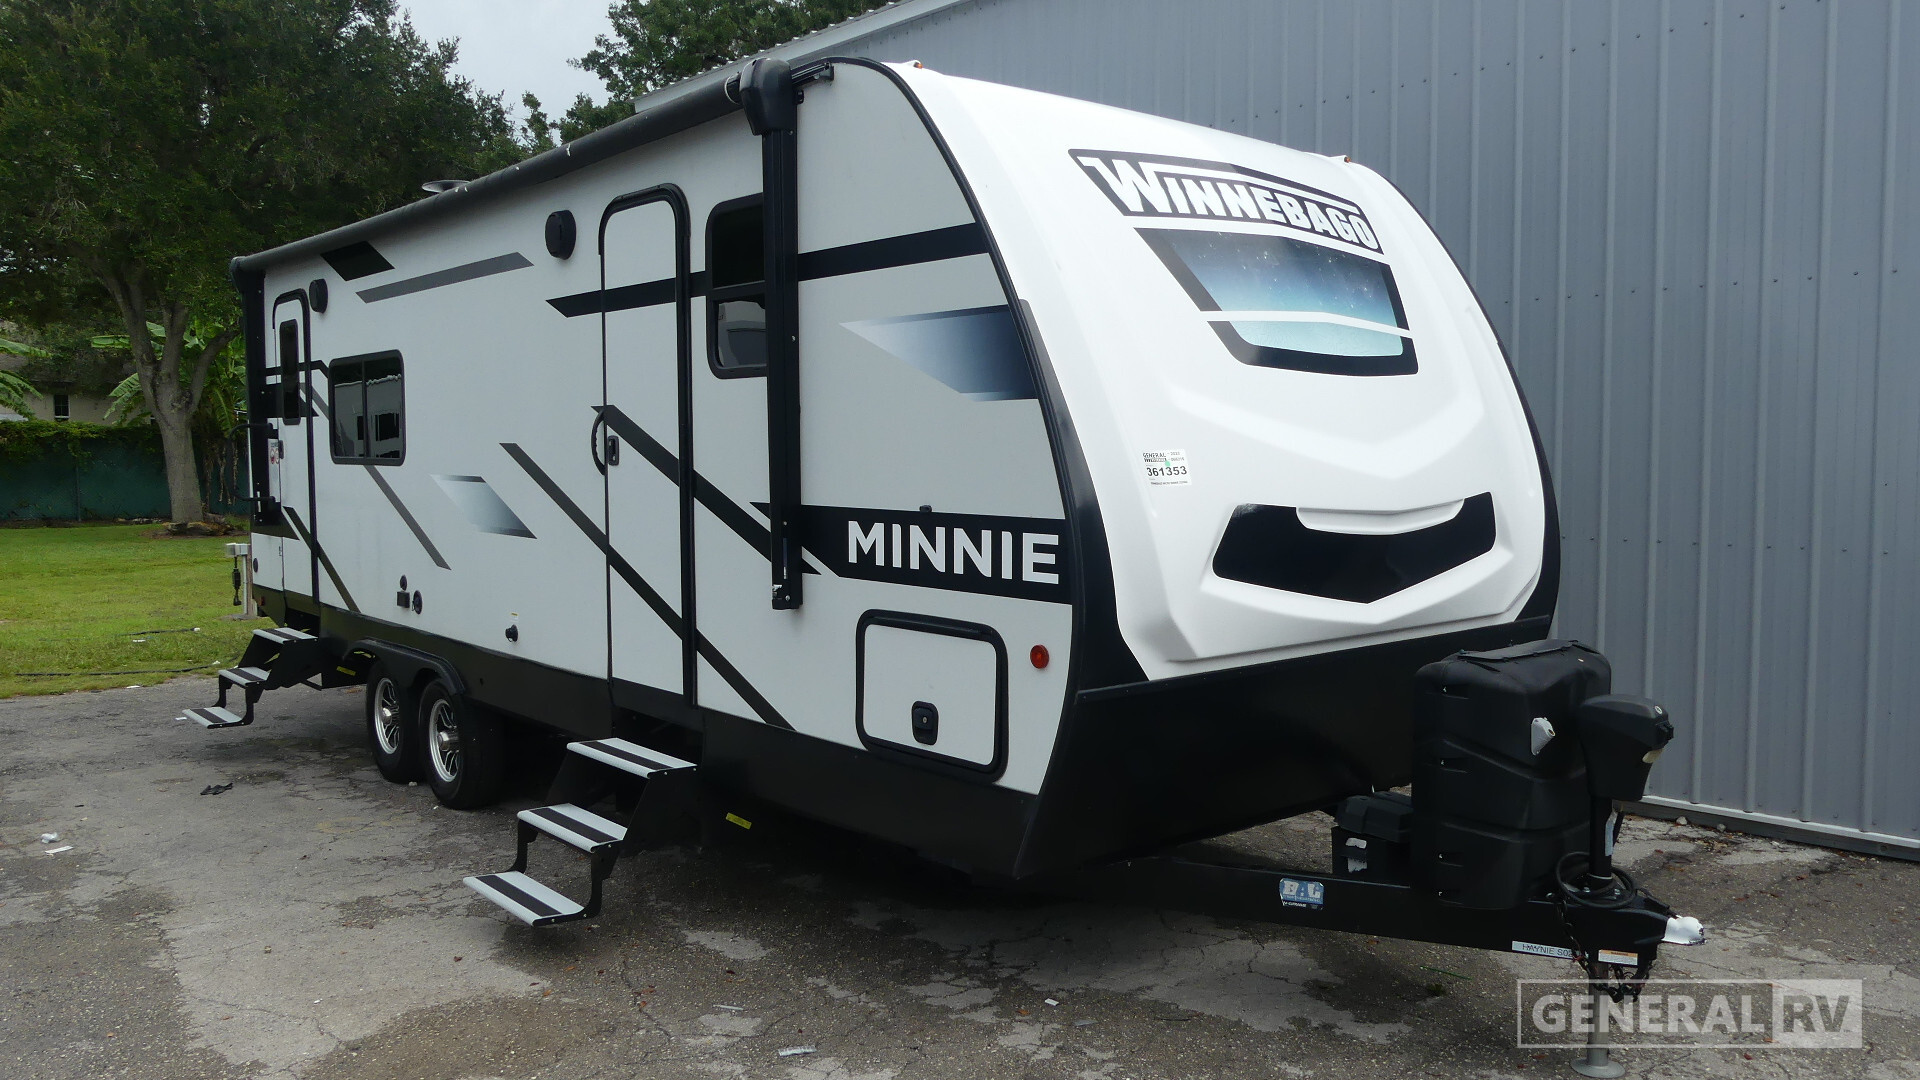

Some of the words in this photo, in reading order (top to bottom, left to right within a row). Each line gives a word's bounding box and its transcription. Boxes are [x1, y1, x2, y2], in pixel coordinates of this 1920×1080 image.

[1077, 155, 1379, 250] WINNEBAGO
[1146, 465, 1188, 477] 361353
[847, 520, 1059, 585] MINNIE
